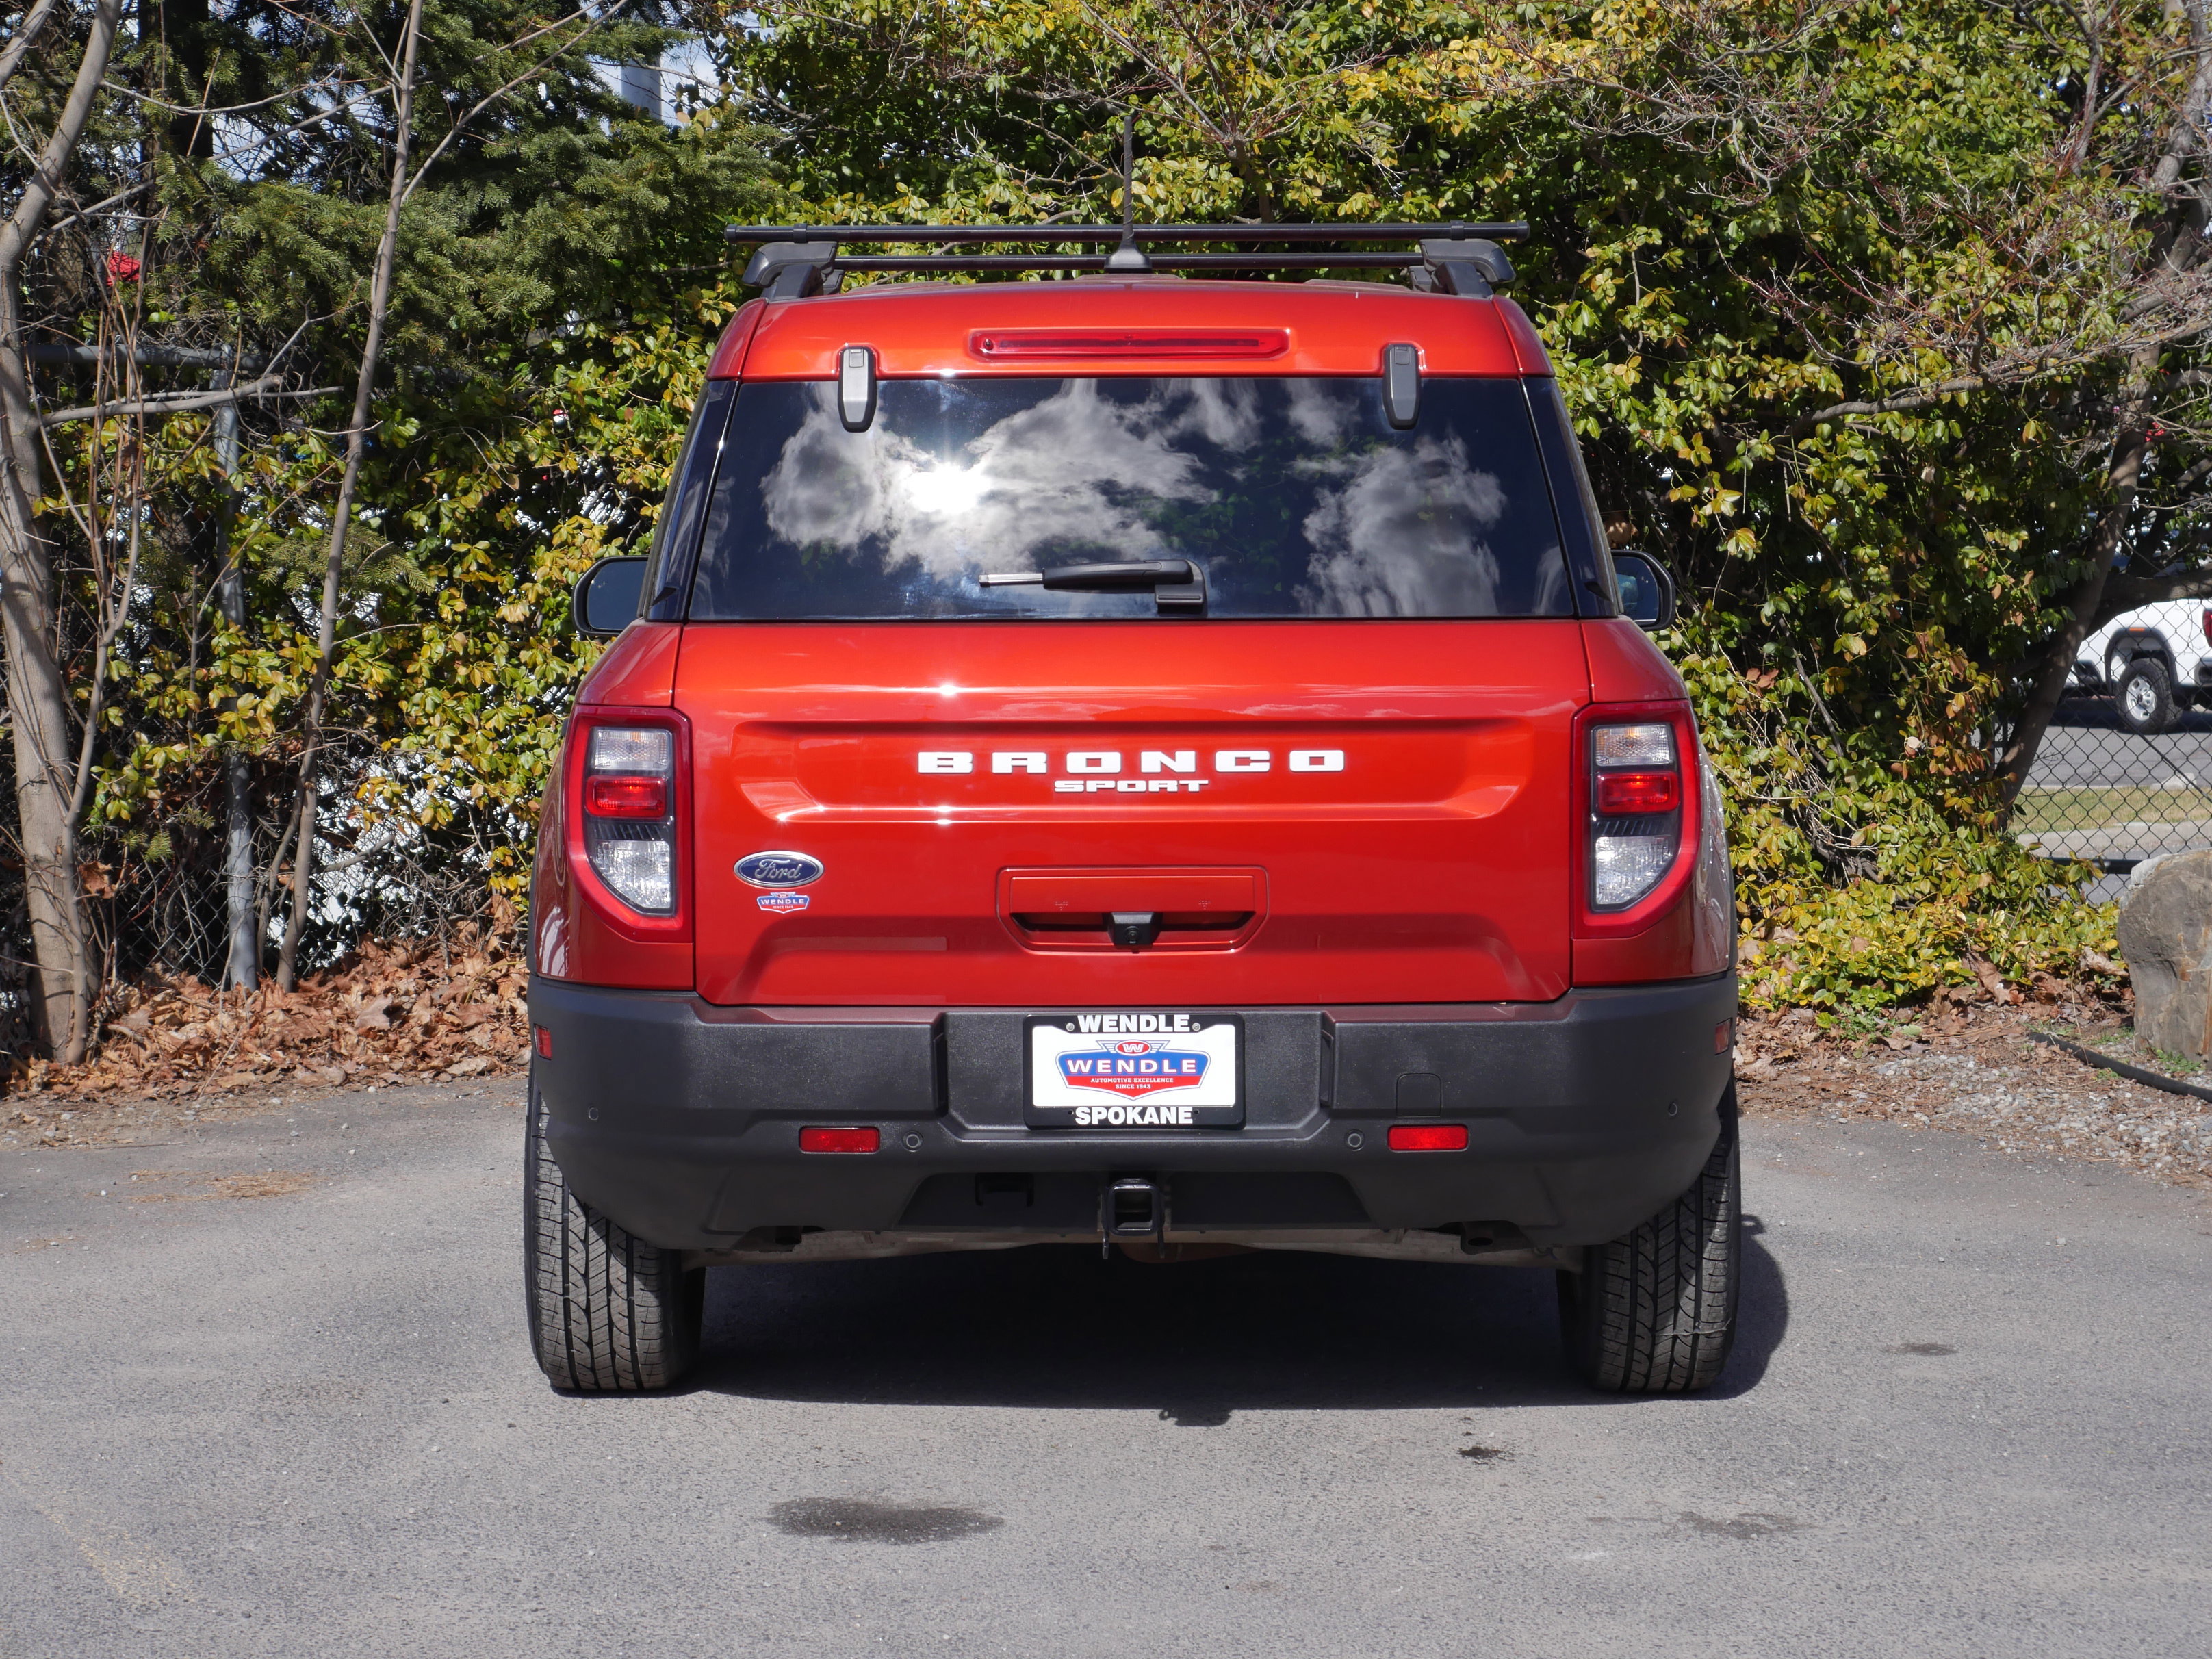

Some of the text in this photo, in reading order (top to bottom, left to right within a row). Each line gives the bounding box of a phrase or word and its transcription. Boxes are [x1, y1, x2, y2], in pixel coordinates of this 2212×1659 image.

[918, 750, 1344, 773] BRONCO
[1055, 780, 1209, 793] SPORT
[754, 858, 802, 879] Ford
[1077, 1014, 1190, 1033] WENDLE
[1122, 1044, 1144, 1053] W
[1066, 1059, 1196, 1073] WENDLE
[1075, 1106, 1193, 1125] SPOKANE
